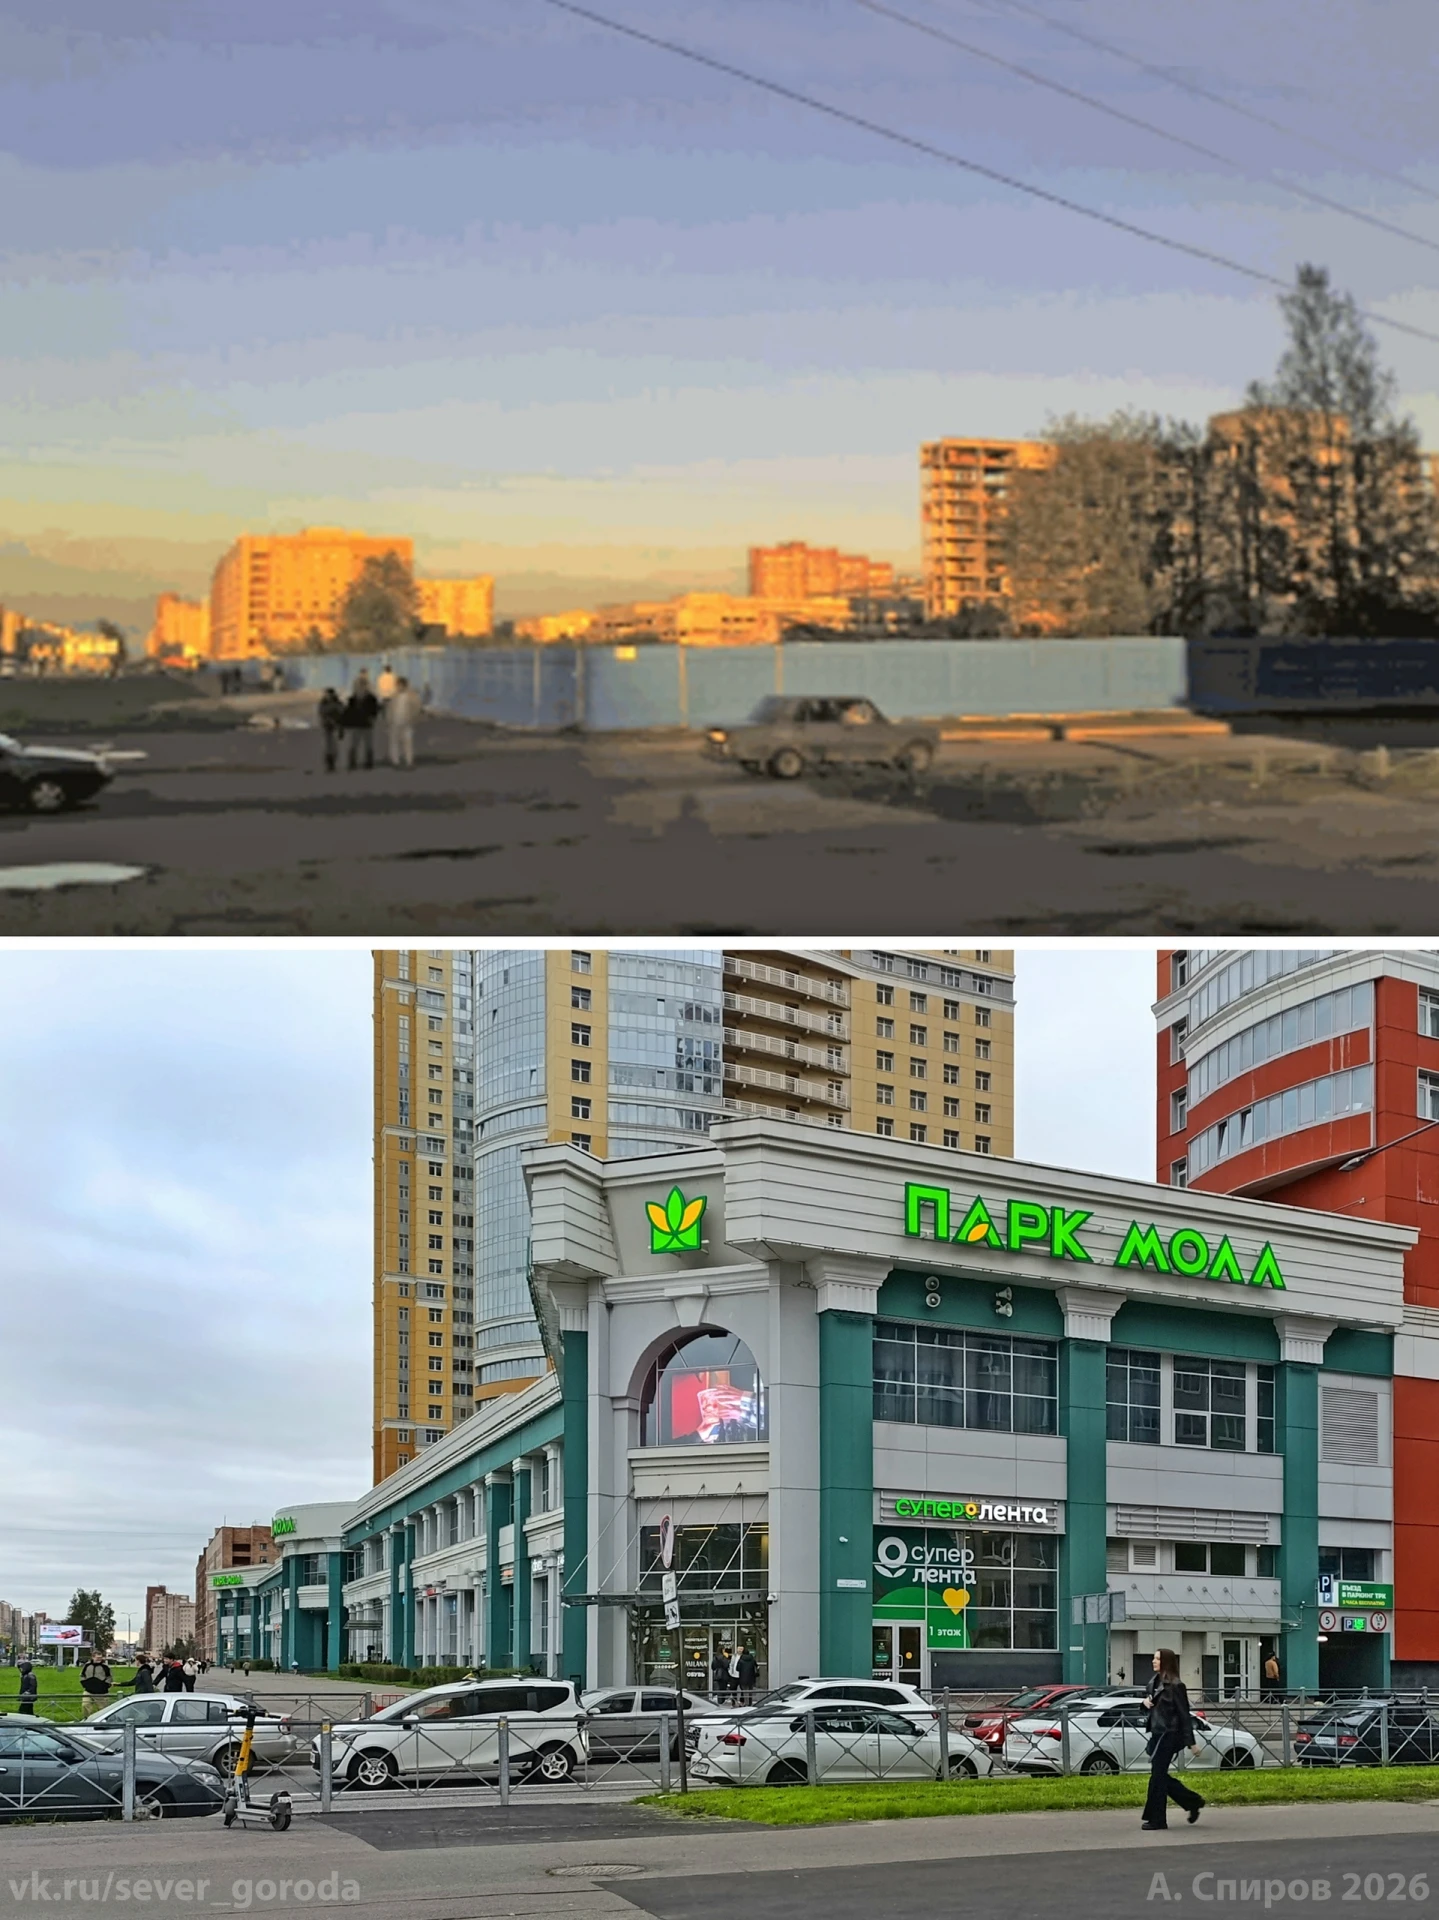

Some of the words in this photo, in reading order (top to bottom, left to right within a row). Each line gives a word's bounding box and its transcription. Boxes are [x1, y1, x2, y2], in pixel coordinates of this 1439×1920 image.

[905, 1181, 1094, 1263] ПАРК
[1114, 1220, 1286, 1290] МОЛЛ
[978, 1503, 1049, 1524] лента
[911, 1545, 975, 1567] супер
[912, 1567, 977, 1585] лента
[1325, 1616, 1330, 1625] 5
[929, 1626, 934, 1636] 1
[937, 1627, 961, 1637] этаж
